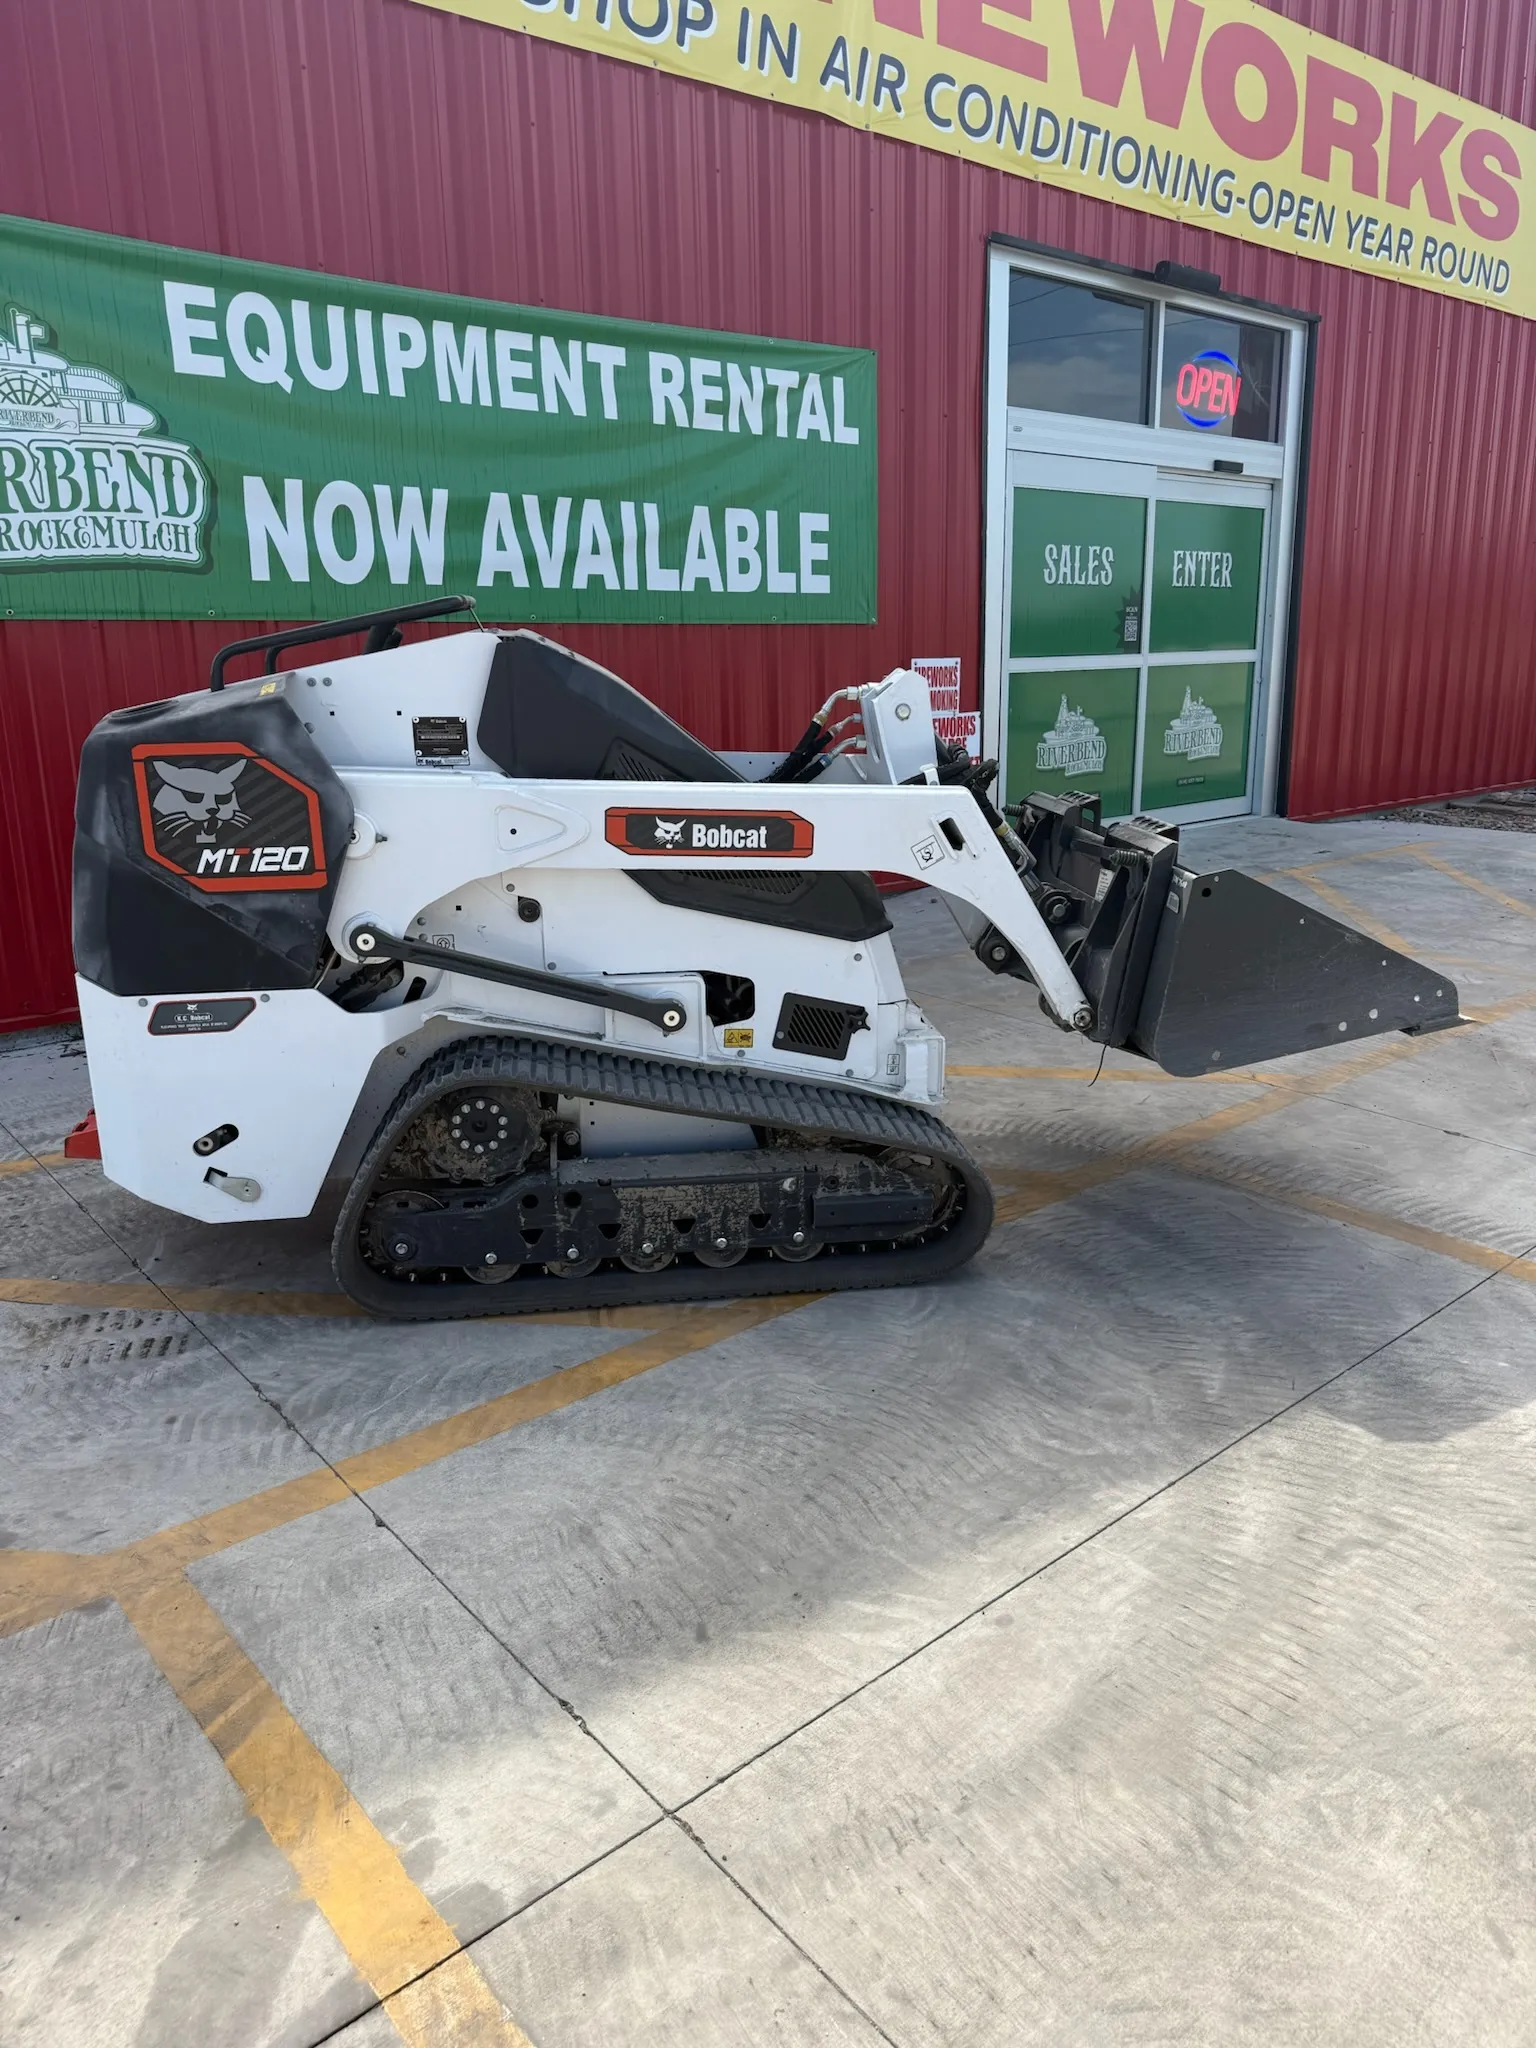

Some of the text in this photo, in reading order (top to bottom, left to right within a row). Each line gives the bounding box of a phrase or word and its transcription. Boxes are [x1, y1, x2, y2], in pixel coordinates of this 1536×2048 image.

[737, 6, 798, 79] IN
[819, 35, 906, 114] AIR
[1346, 210, 1413, 267] YEAR
[1421, 236, 1511, 295] ROUND
[162, 280, 860, 446] EQUIPMENT RENTAL
[1176, 363, 1243, 417] OPEN
[242, 475, 832, 594] NOW AVAILABLE
[1043, 543, 1115, 586] SALES
[1171, 549, 1233, 588] ENTER
[1037, 740, 1105, 767] RIVERBEND
[1164, 727, 1222, 752] RIVERBEND
[691, 823, 768, 849] Bobcat
